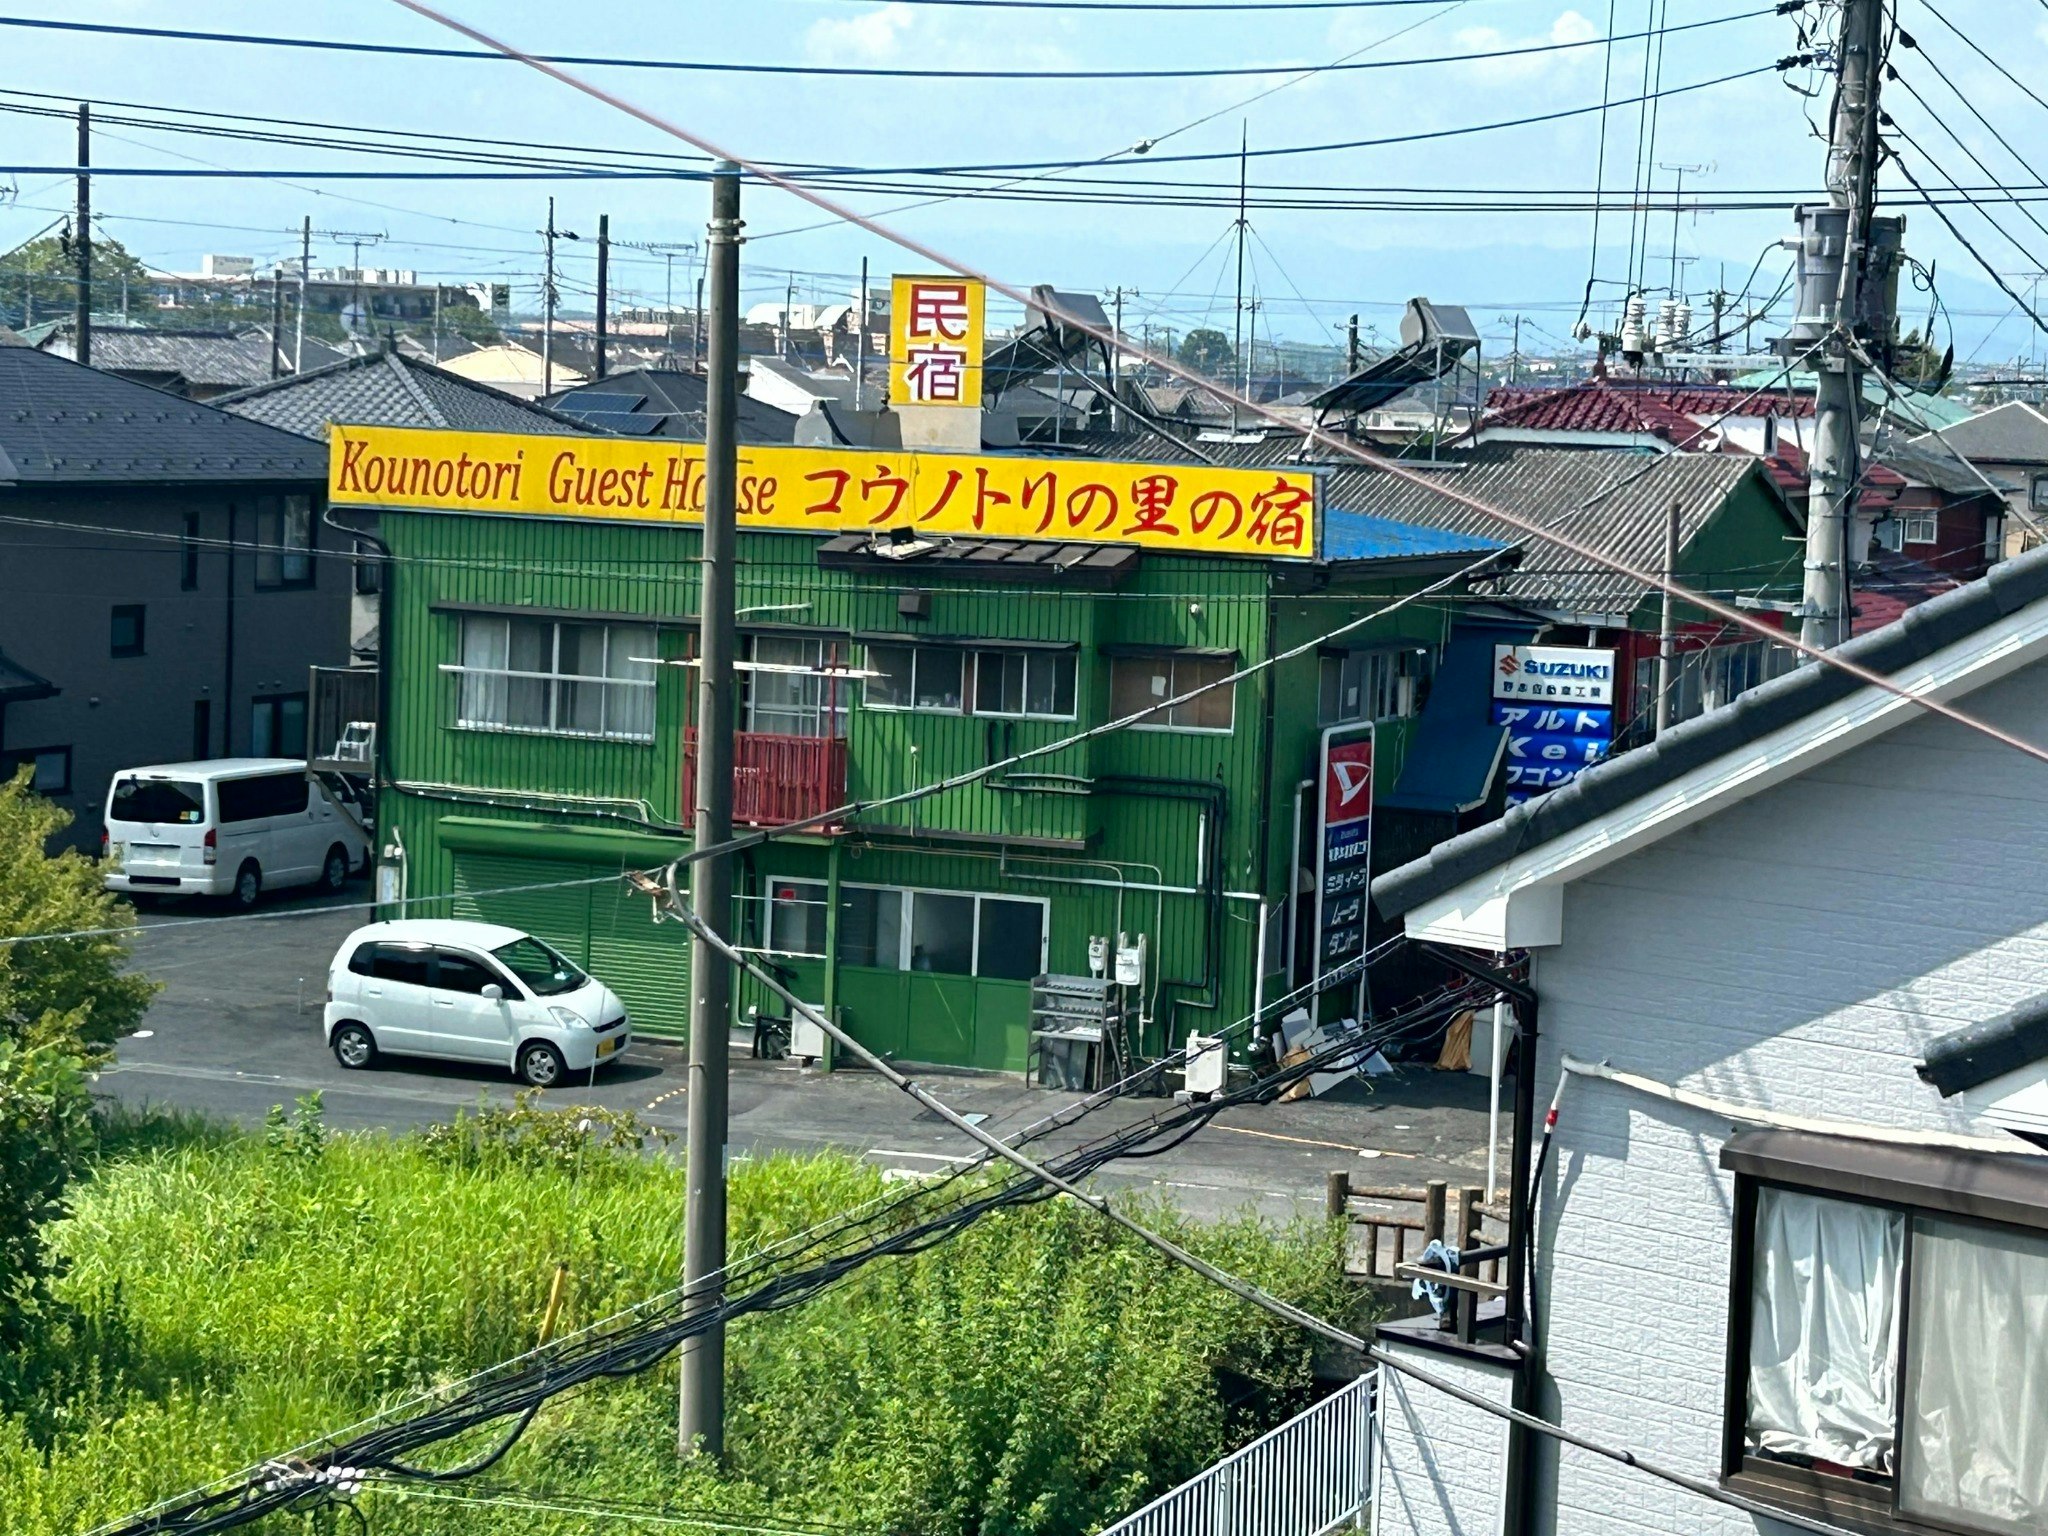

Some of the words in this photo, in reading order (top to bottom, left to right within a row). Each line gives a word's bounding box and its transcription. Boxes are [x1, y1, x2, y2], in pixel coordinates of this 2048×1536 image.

[907, 284, 968, 400] 民宿
[337, 440, 525, 501] Kounotori
[549, 451, 653, 508] Guest
[660, 457, 777, 515] Hose
[804, 464, 1314, 550] コウノトリの里の宿
[1524, 660, 1609, 679] SUZUKI
[1500, 707, 1600, 733] アルト
[1508, 736, 1600, 762] Kei
